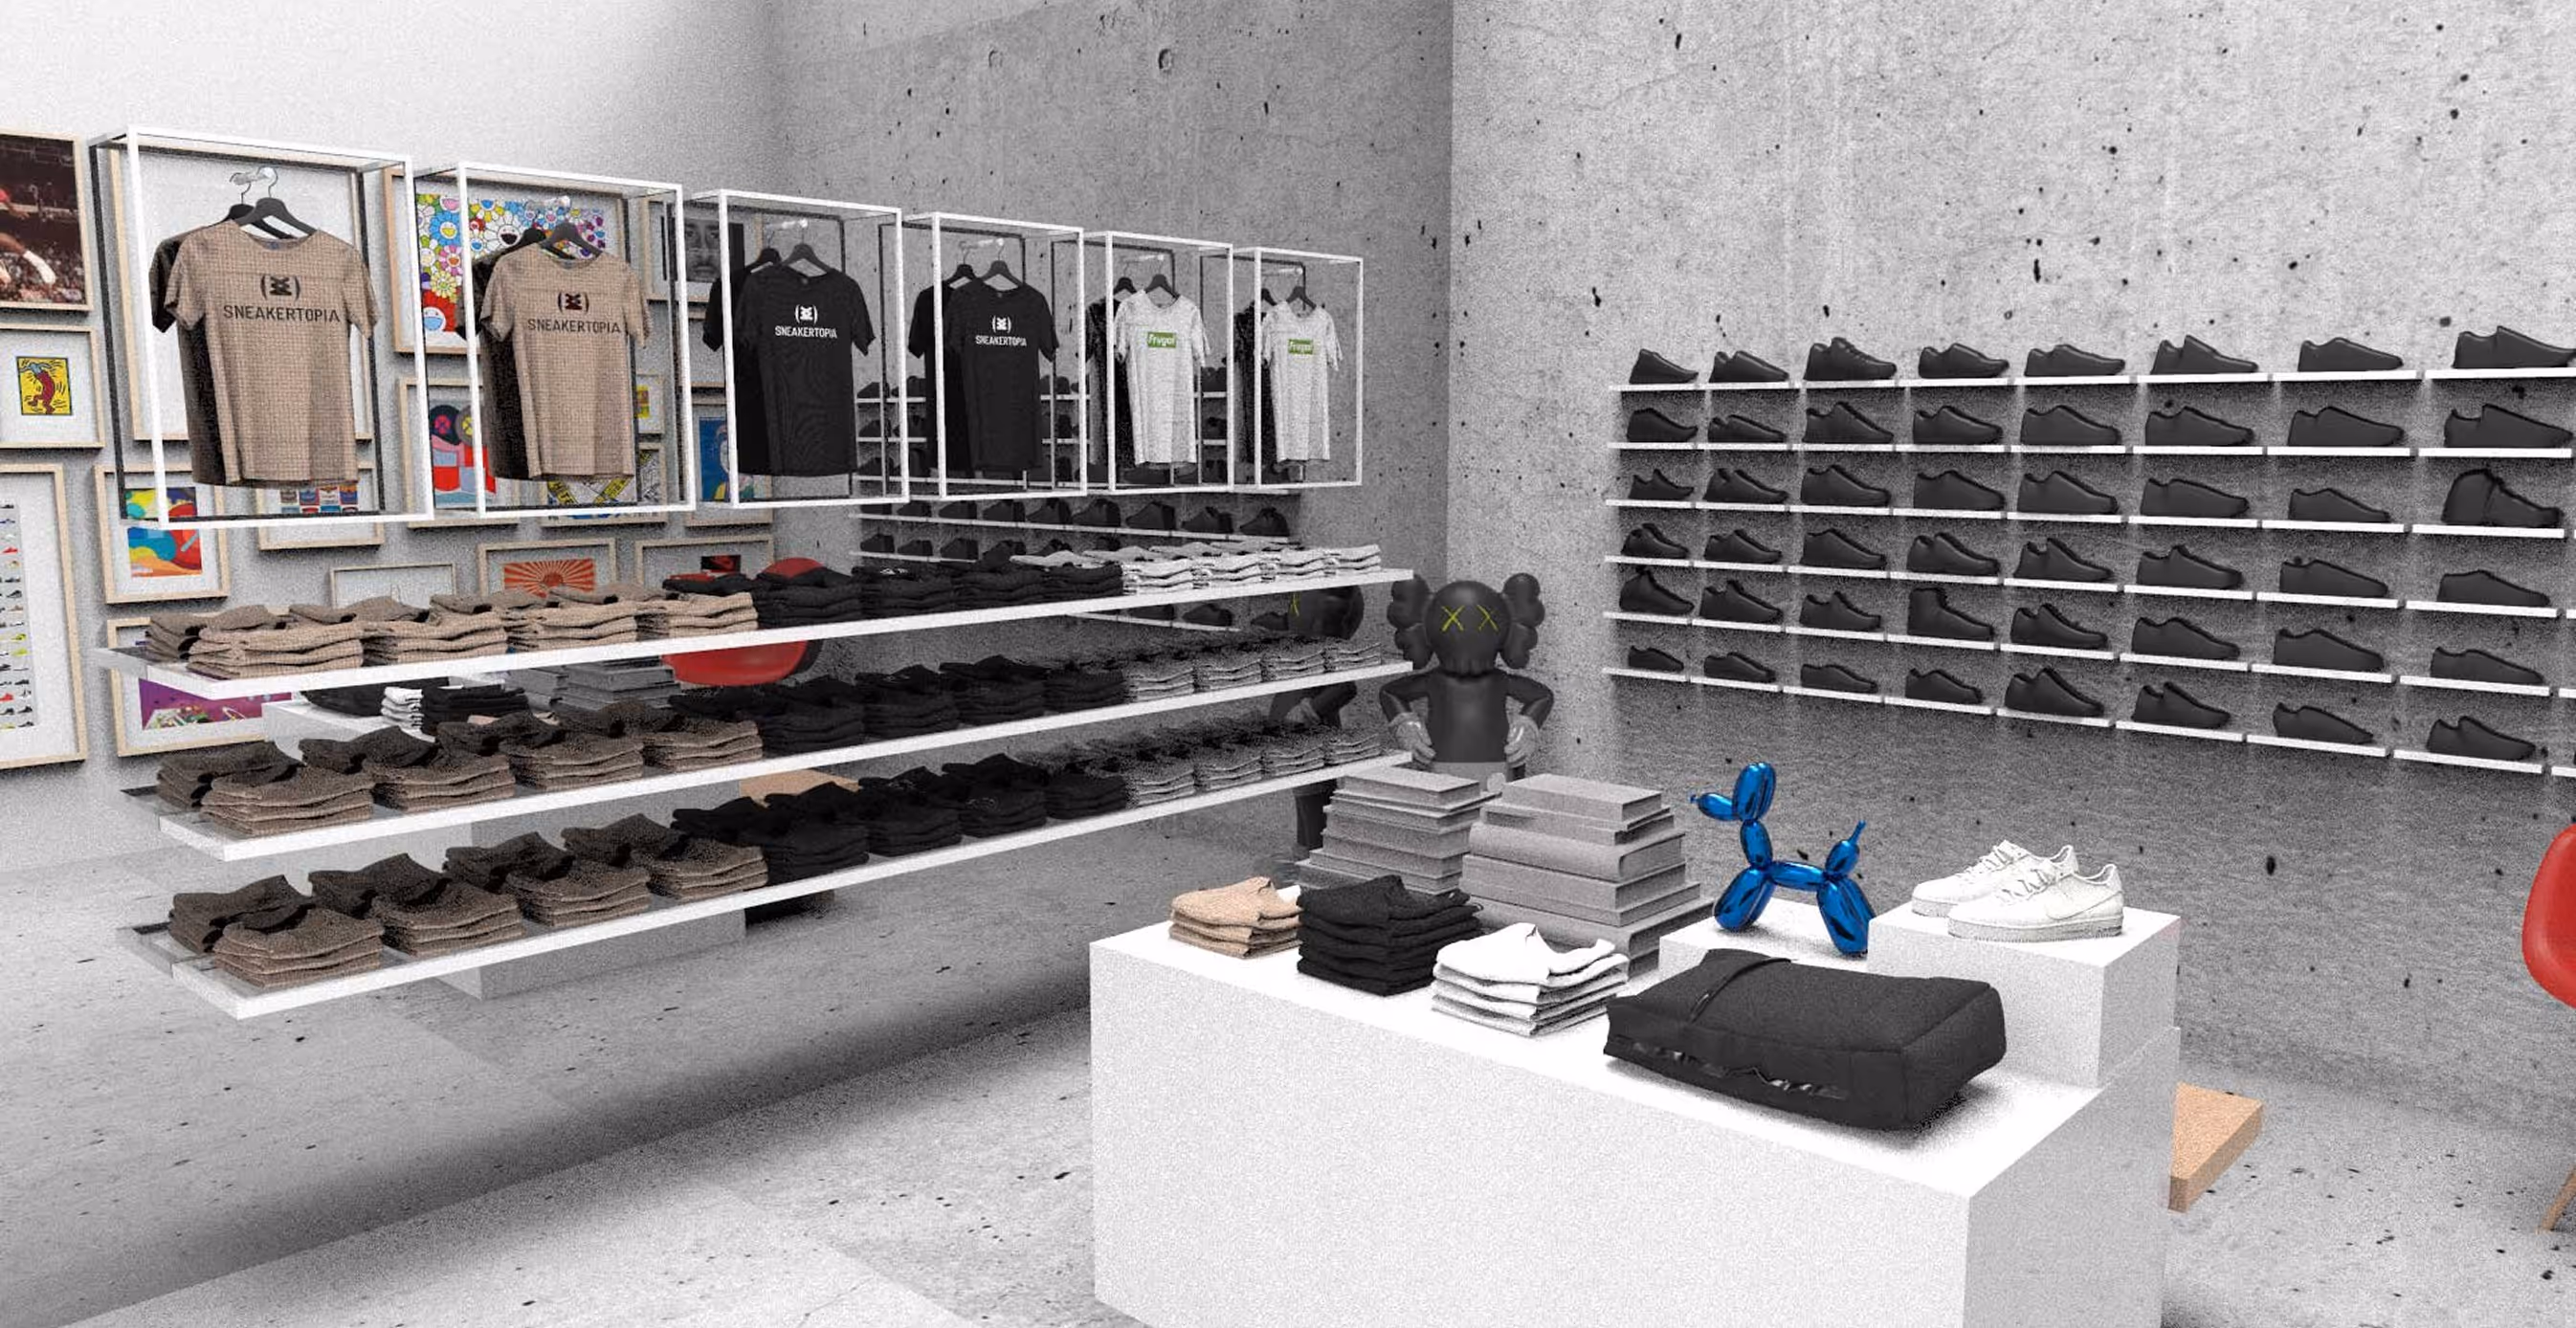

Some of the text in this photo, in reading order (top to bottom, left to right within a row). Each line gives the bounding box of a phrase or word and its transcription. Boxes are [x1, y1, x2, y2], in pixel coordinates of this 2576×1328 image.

[223, 305, 341, 322] SNEAKERTOPIA
[527, 319, 621, 334] SNEAKERTOPIA
[774, 325, 838, 339] SNEAKERTOPIA
